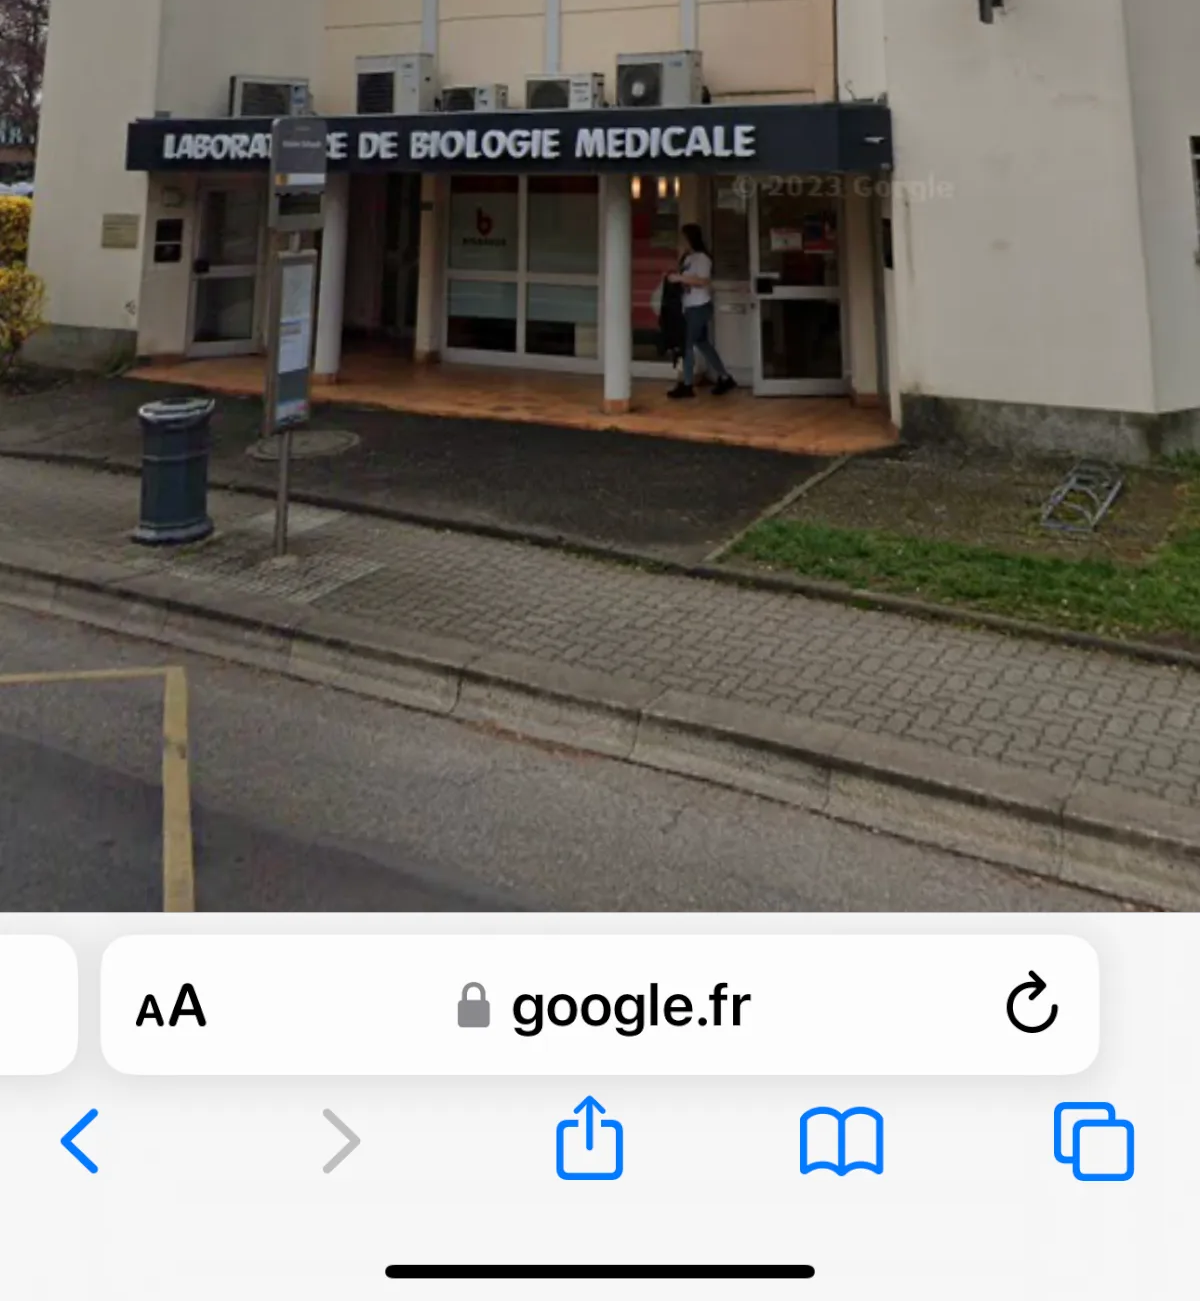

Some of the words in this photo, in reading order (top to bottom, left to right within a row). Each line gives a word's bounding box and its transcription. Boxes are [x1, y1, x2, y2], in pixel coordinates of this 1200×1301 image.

[359, 131, 398, 159] DE
[410, 128, 561, 159] BIOLOGIE
[575, 125, 756, 158] MEDICALE
